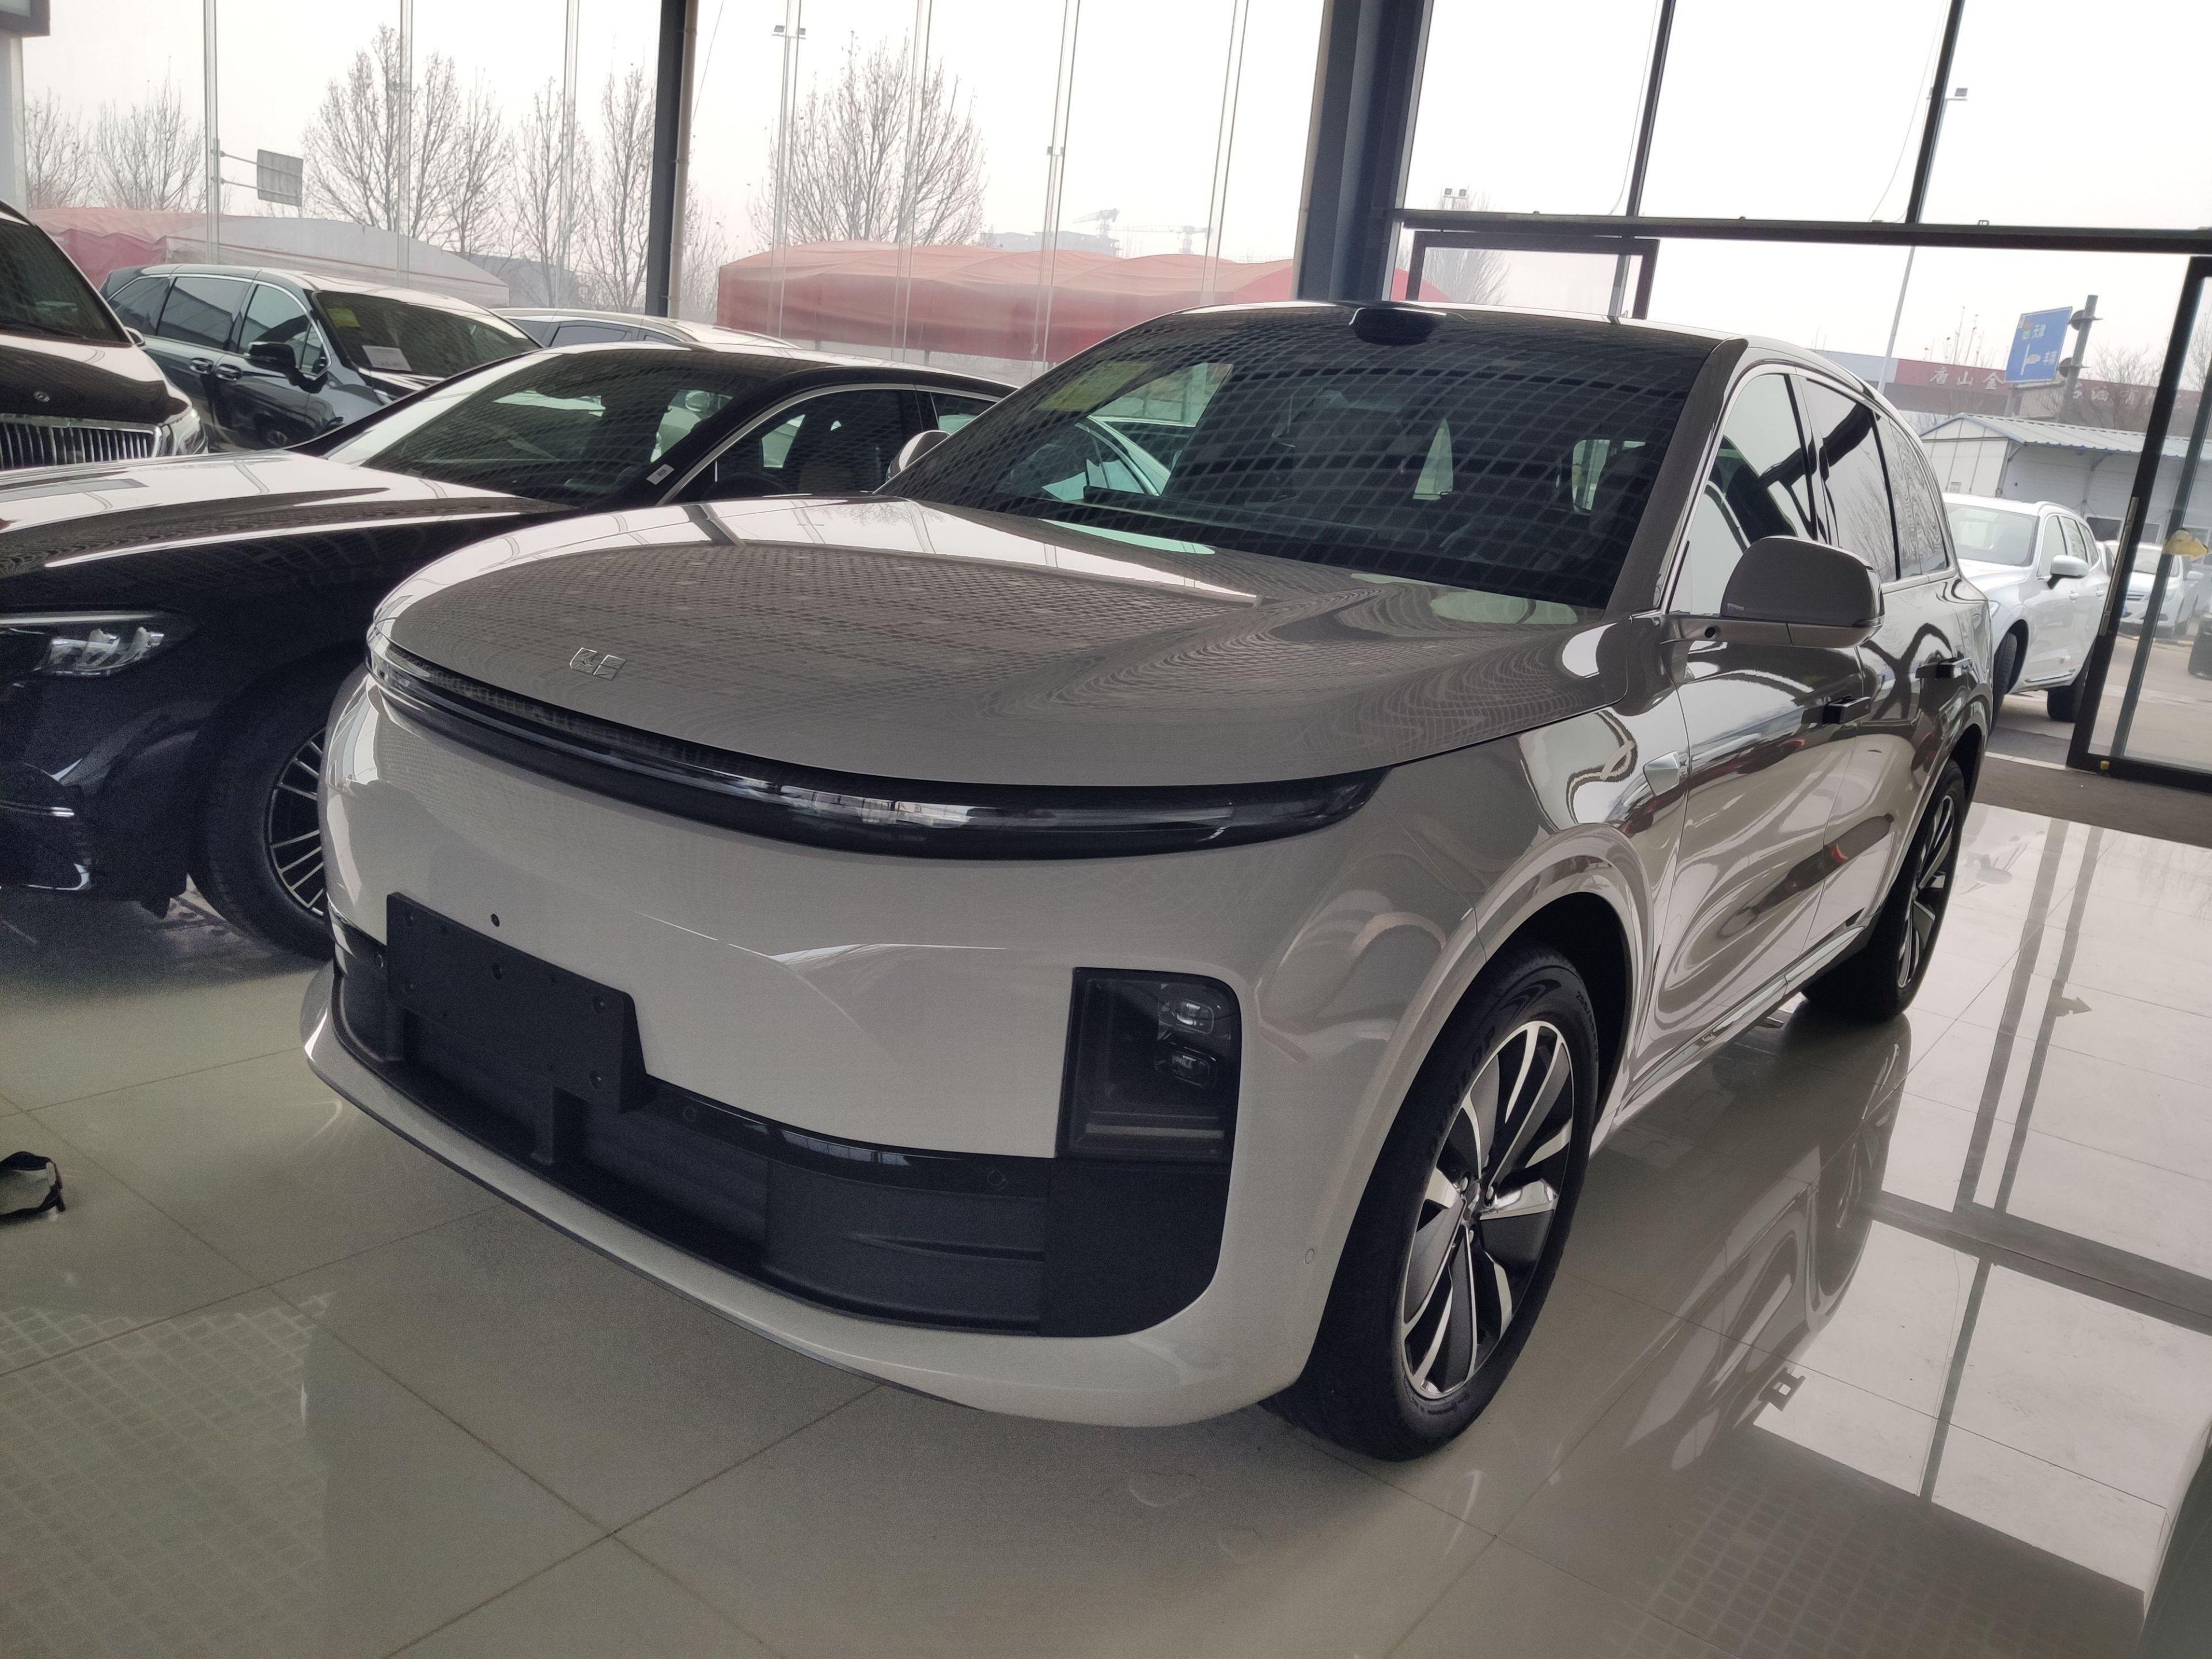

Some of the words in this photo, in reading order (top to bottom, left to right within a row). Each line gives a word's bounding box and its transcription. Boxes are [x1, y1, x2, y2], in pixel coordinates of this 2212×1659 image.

[1930, 366, 2005, 390] 唐山金
[1427, 1025, 1496, 1161] DUNLOP
